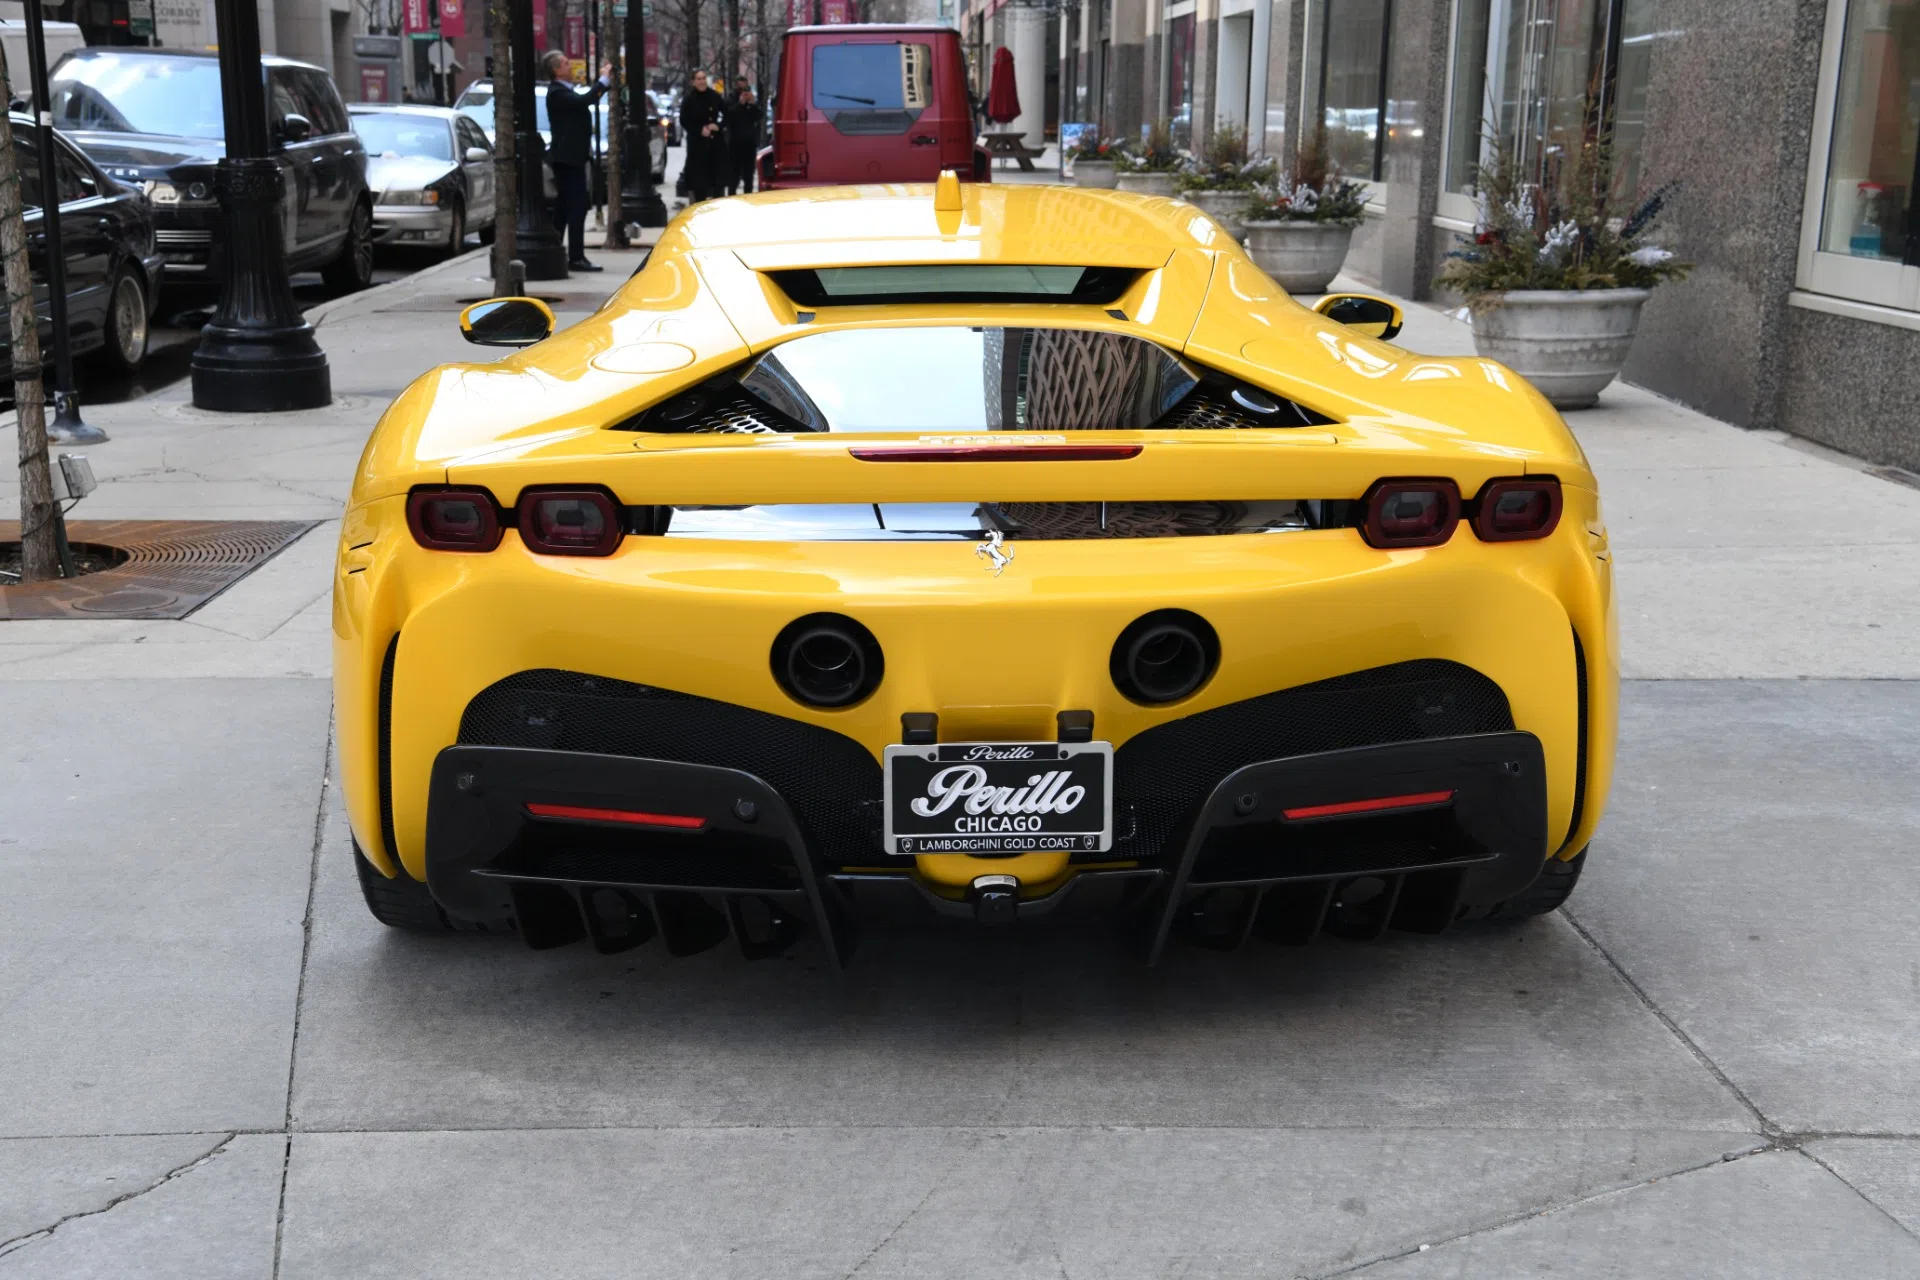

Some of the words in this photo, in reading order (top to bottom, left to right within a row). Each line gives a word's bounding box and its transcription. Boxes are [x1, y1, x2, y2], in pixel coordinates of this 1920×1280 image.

[962, 745, 1034, 760] Perillo
[910, 764, 1086, 817] Perillo
[954, 815, 1042, 832] CHICAGO
[920, 838, 1001, 851] LAMBORGHINI
[1003, 838, 1036, 849] GOLD
[1039, 837, 1076, 848] COAST
